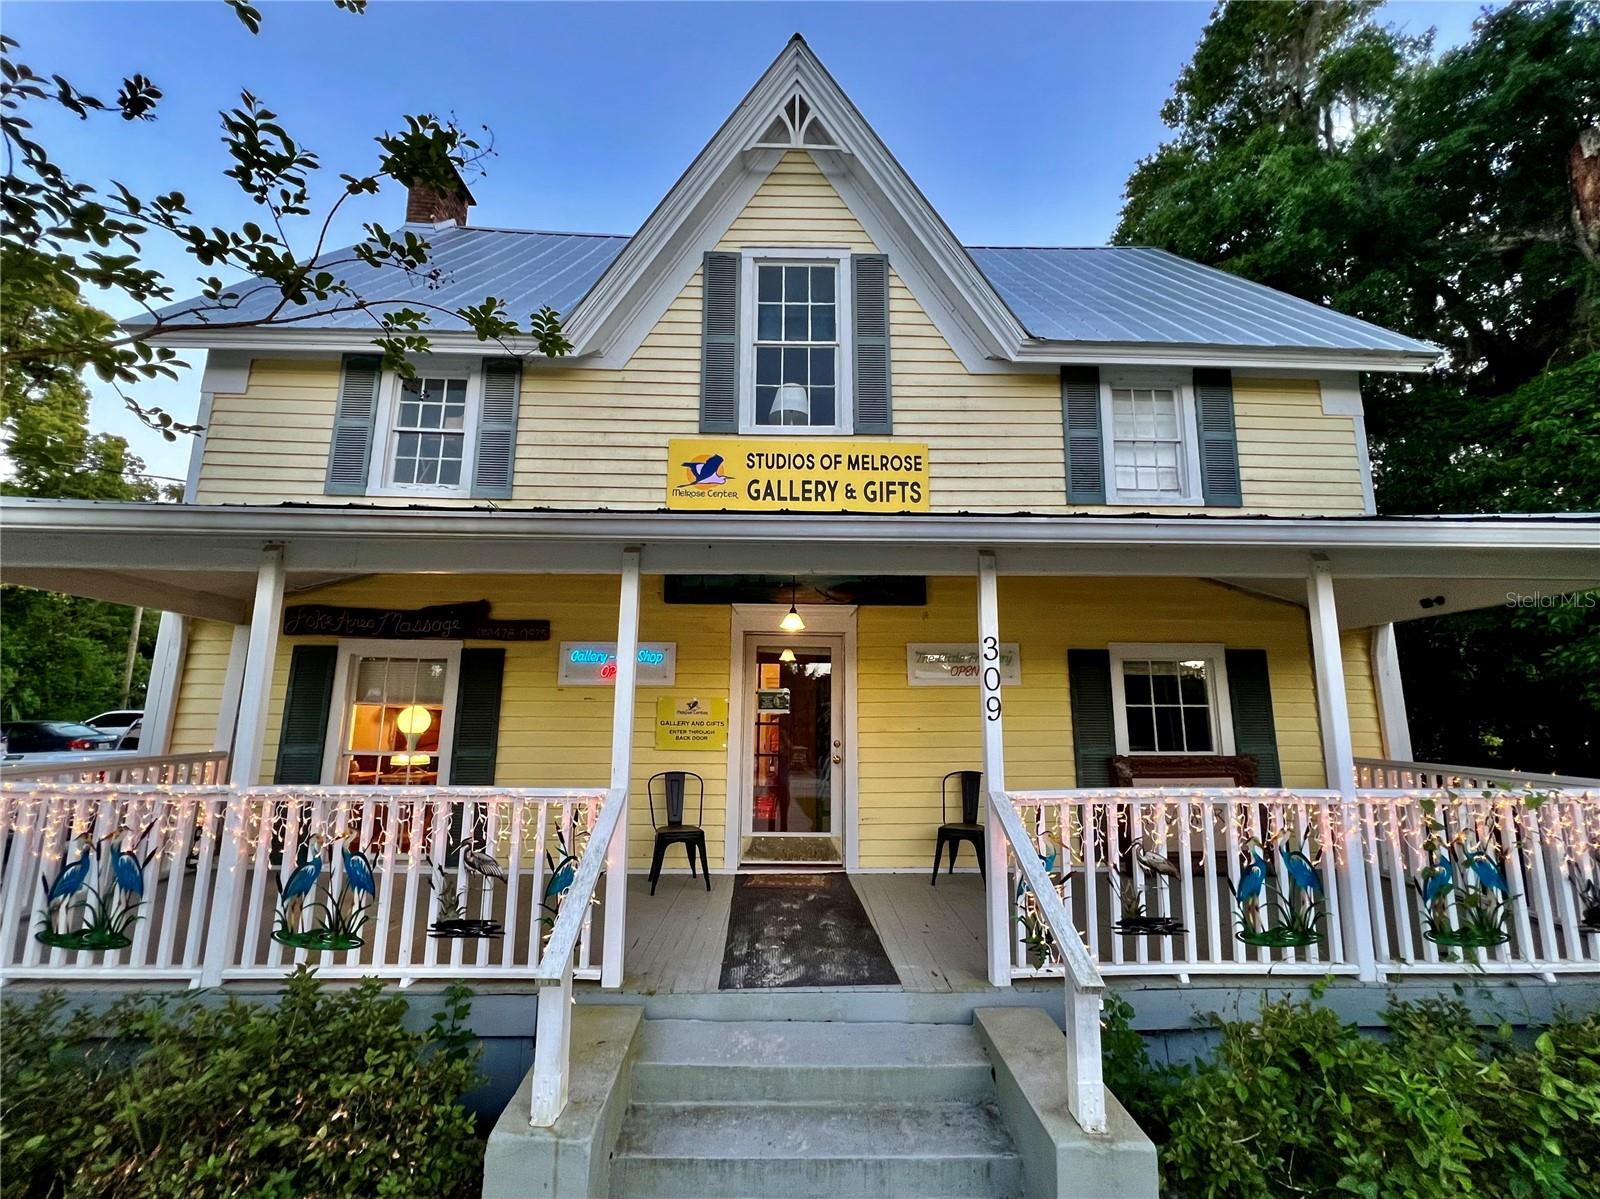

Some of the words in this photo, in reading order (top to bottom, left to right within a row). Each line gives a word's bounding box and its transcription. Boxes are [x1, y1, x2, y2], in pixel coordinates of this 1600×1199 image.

[746, 452, 815, 470] STUDIOS
[820, 453, 842, 470] OF
[847, 454, 922, 472] MELROSE
[672, 489, 705, 498] Melrose
[707, 489, 739, 499] Center
[747, 479, 839, 502] GALLERY
[845, 482, 857, 500] &
[863, 480, 922, 503] GIFTS
[372, 612, 461, 637] Massage
[637, 649, 663, 664] Shop
[600, 665, 617, 678] OP
[950, 665, 980, 677] OPEN
[983, 636, 1002, 721] 309
